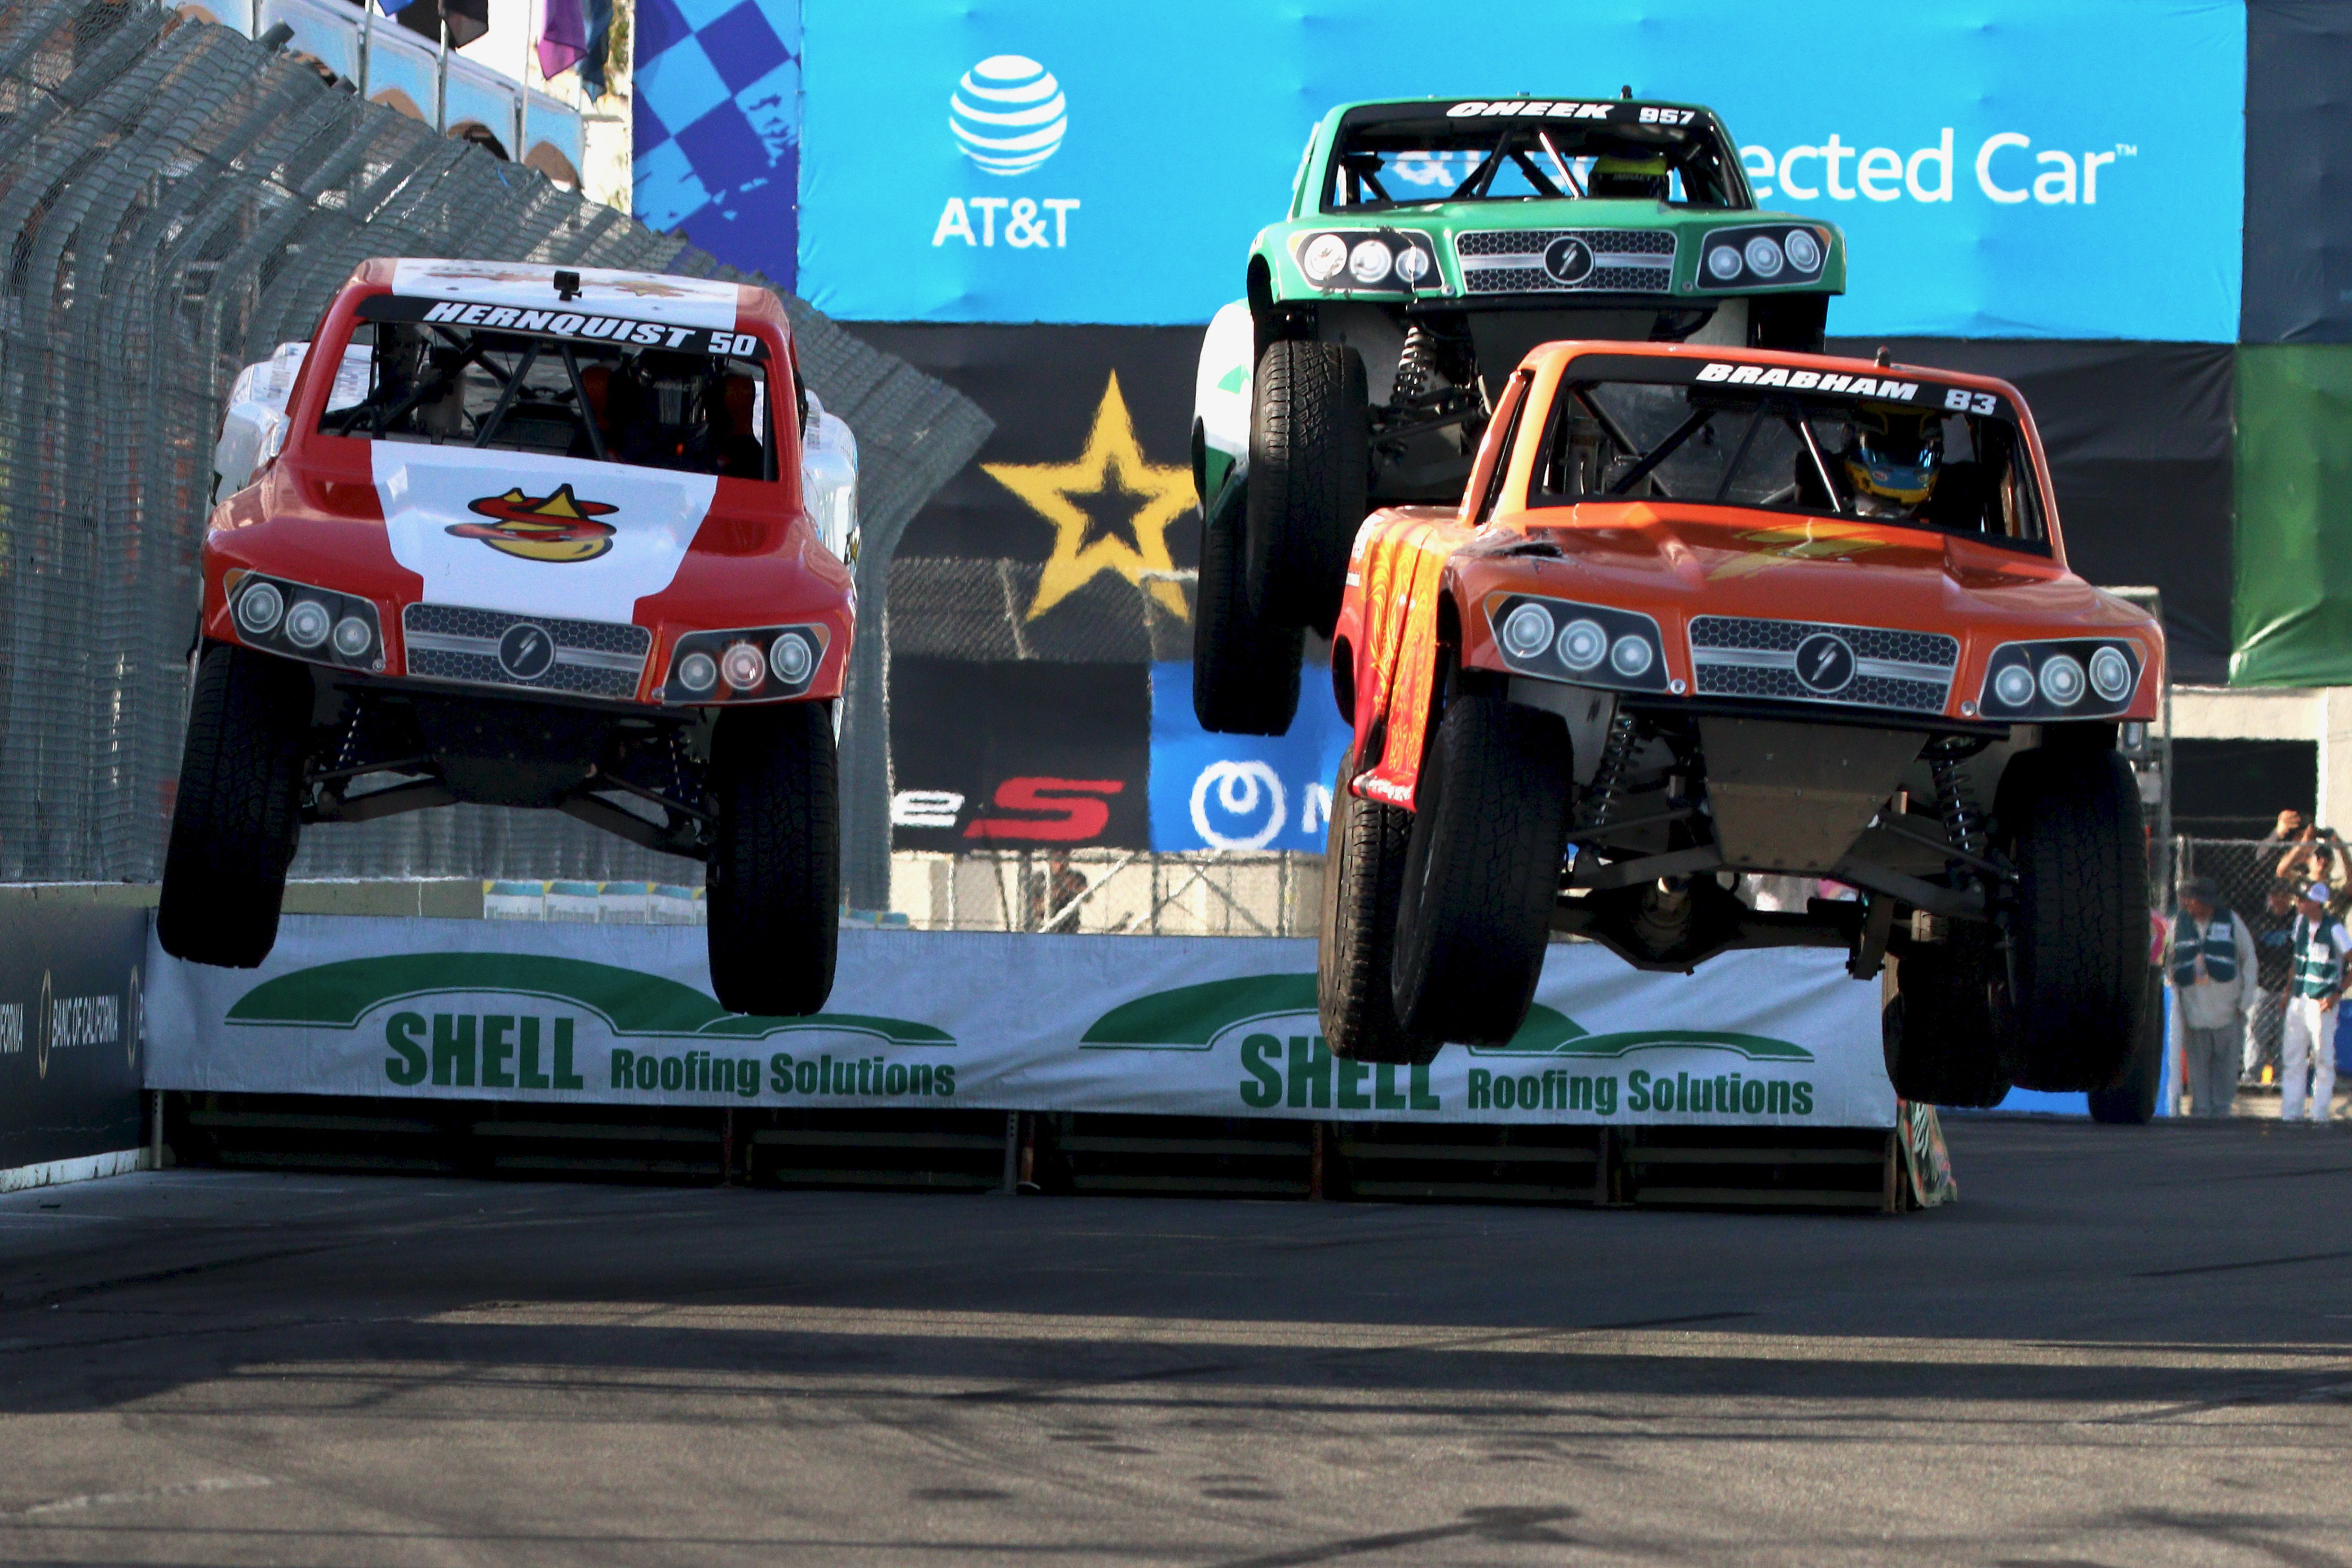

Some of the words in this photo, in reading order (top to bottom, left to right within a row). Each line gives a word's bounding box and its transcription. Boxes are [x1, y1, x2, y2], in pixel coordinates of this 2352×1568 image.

[1446, 101, 1615, 119] CHEEK
[1638, 107, 1695, 125] 957
[1739, 127, 1954, 202] ected
[932, 197, 1080, 248] AT&T
[423, 302, 696, 348] HERNQUIST
[708, 331, 758, 356] 50
[1695, 362, 1919, 401] BRABHAM
[1945, 389, 1997, 415] 83
[0, 1003, 23, 1055] FORNIA
[51, 998, 72, 1048] BANC
[72, 996, 83, 1047] OF
[82, 994, 118, 1046] CALIFORNIA
[385, 1011, 584, 1090] SHELL
[611, 1048, 760, 1097] Roofing
[770, 1052, 956, 1097] Solutions
[1240, 1033, 1440, 1111] SHELL
[1468, 1069, 1617, 1115] Roofing
[1628, 1069, 1814, 1115] Solutions
